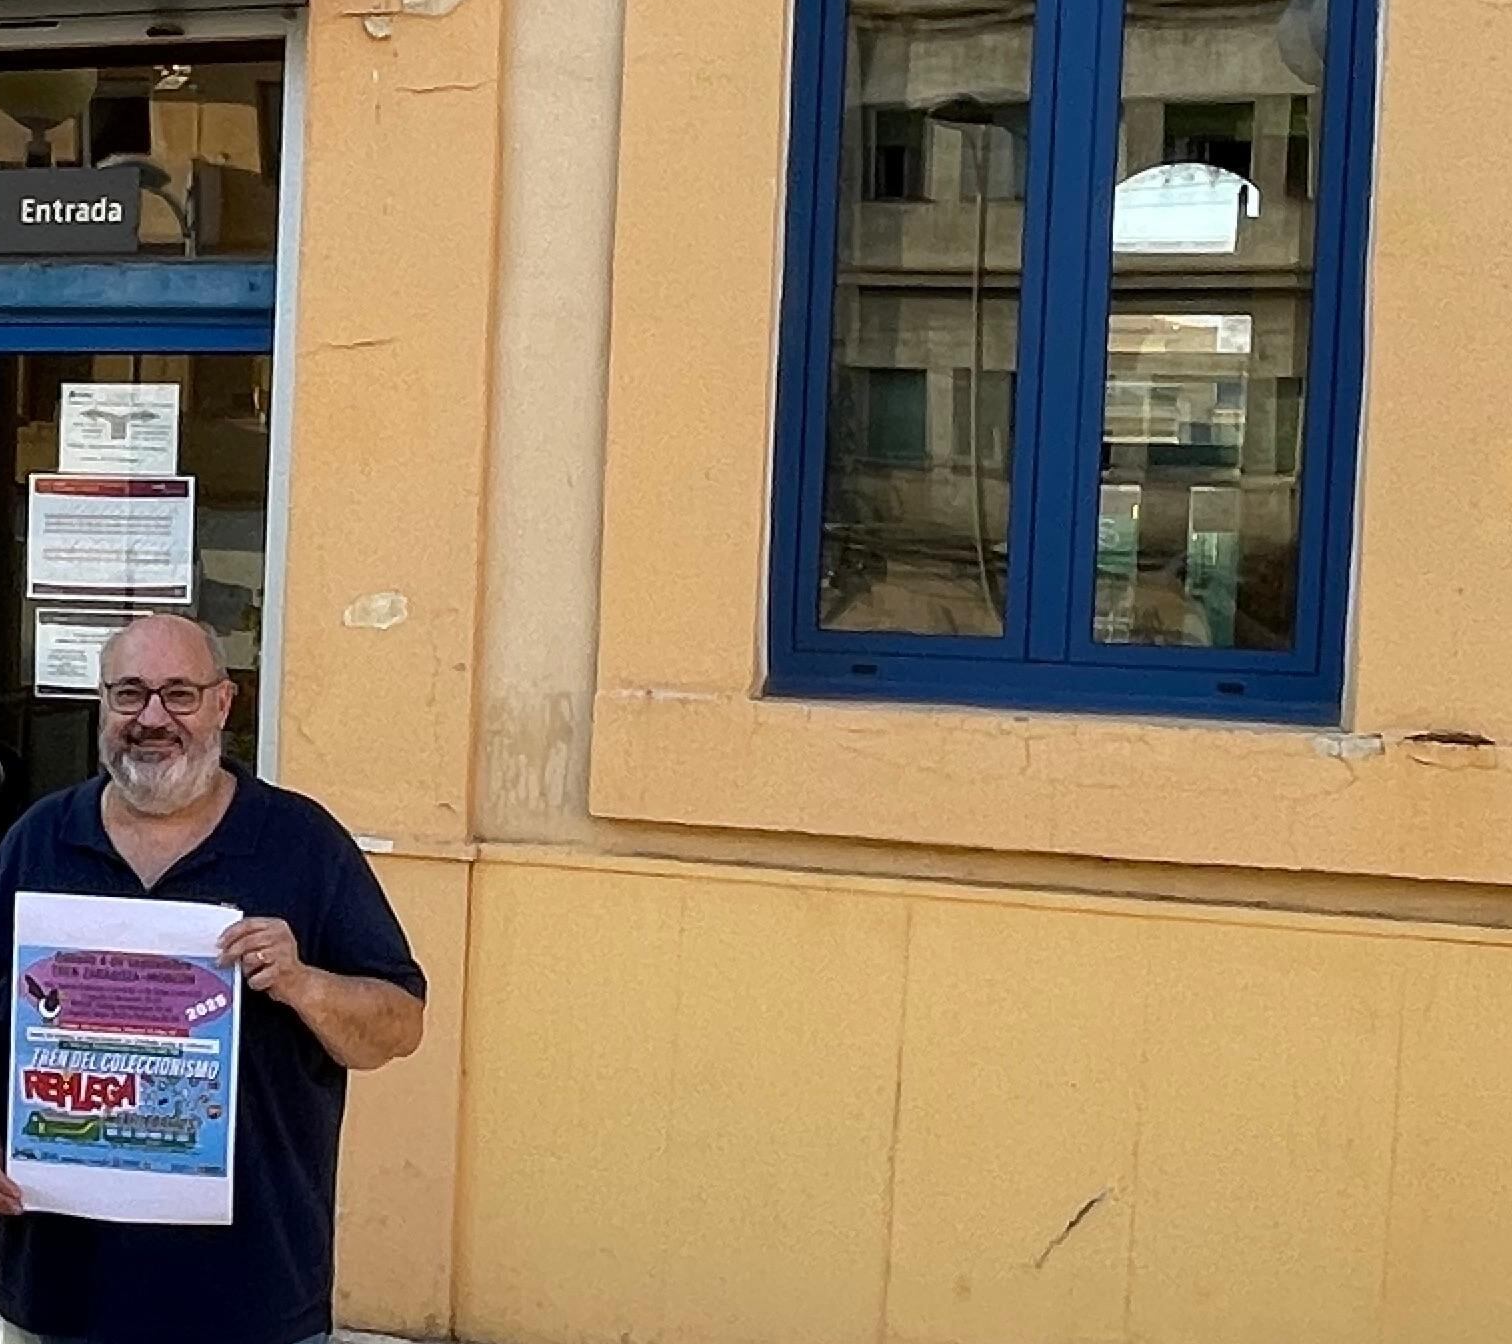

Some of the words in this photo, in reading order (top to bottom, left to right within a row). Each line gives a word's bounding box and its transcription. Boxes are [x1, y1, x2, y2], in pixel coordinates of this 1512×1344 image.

[21, 196, 123, 224] Entrada
[32, 1047, 69, 1067] TREN
[69, 1051, 97, 1070] DEL
[100, 1054, 220, 1080] COLECCIONISMO
